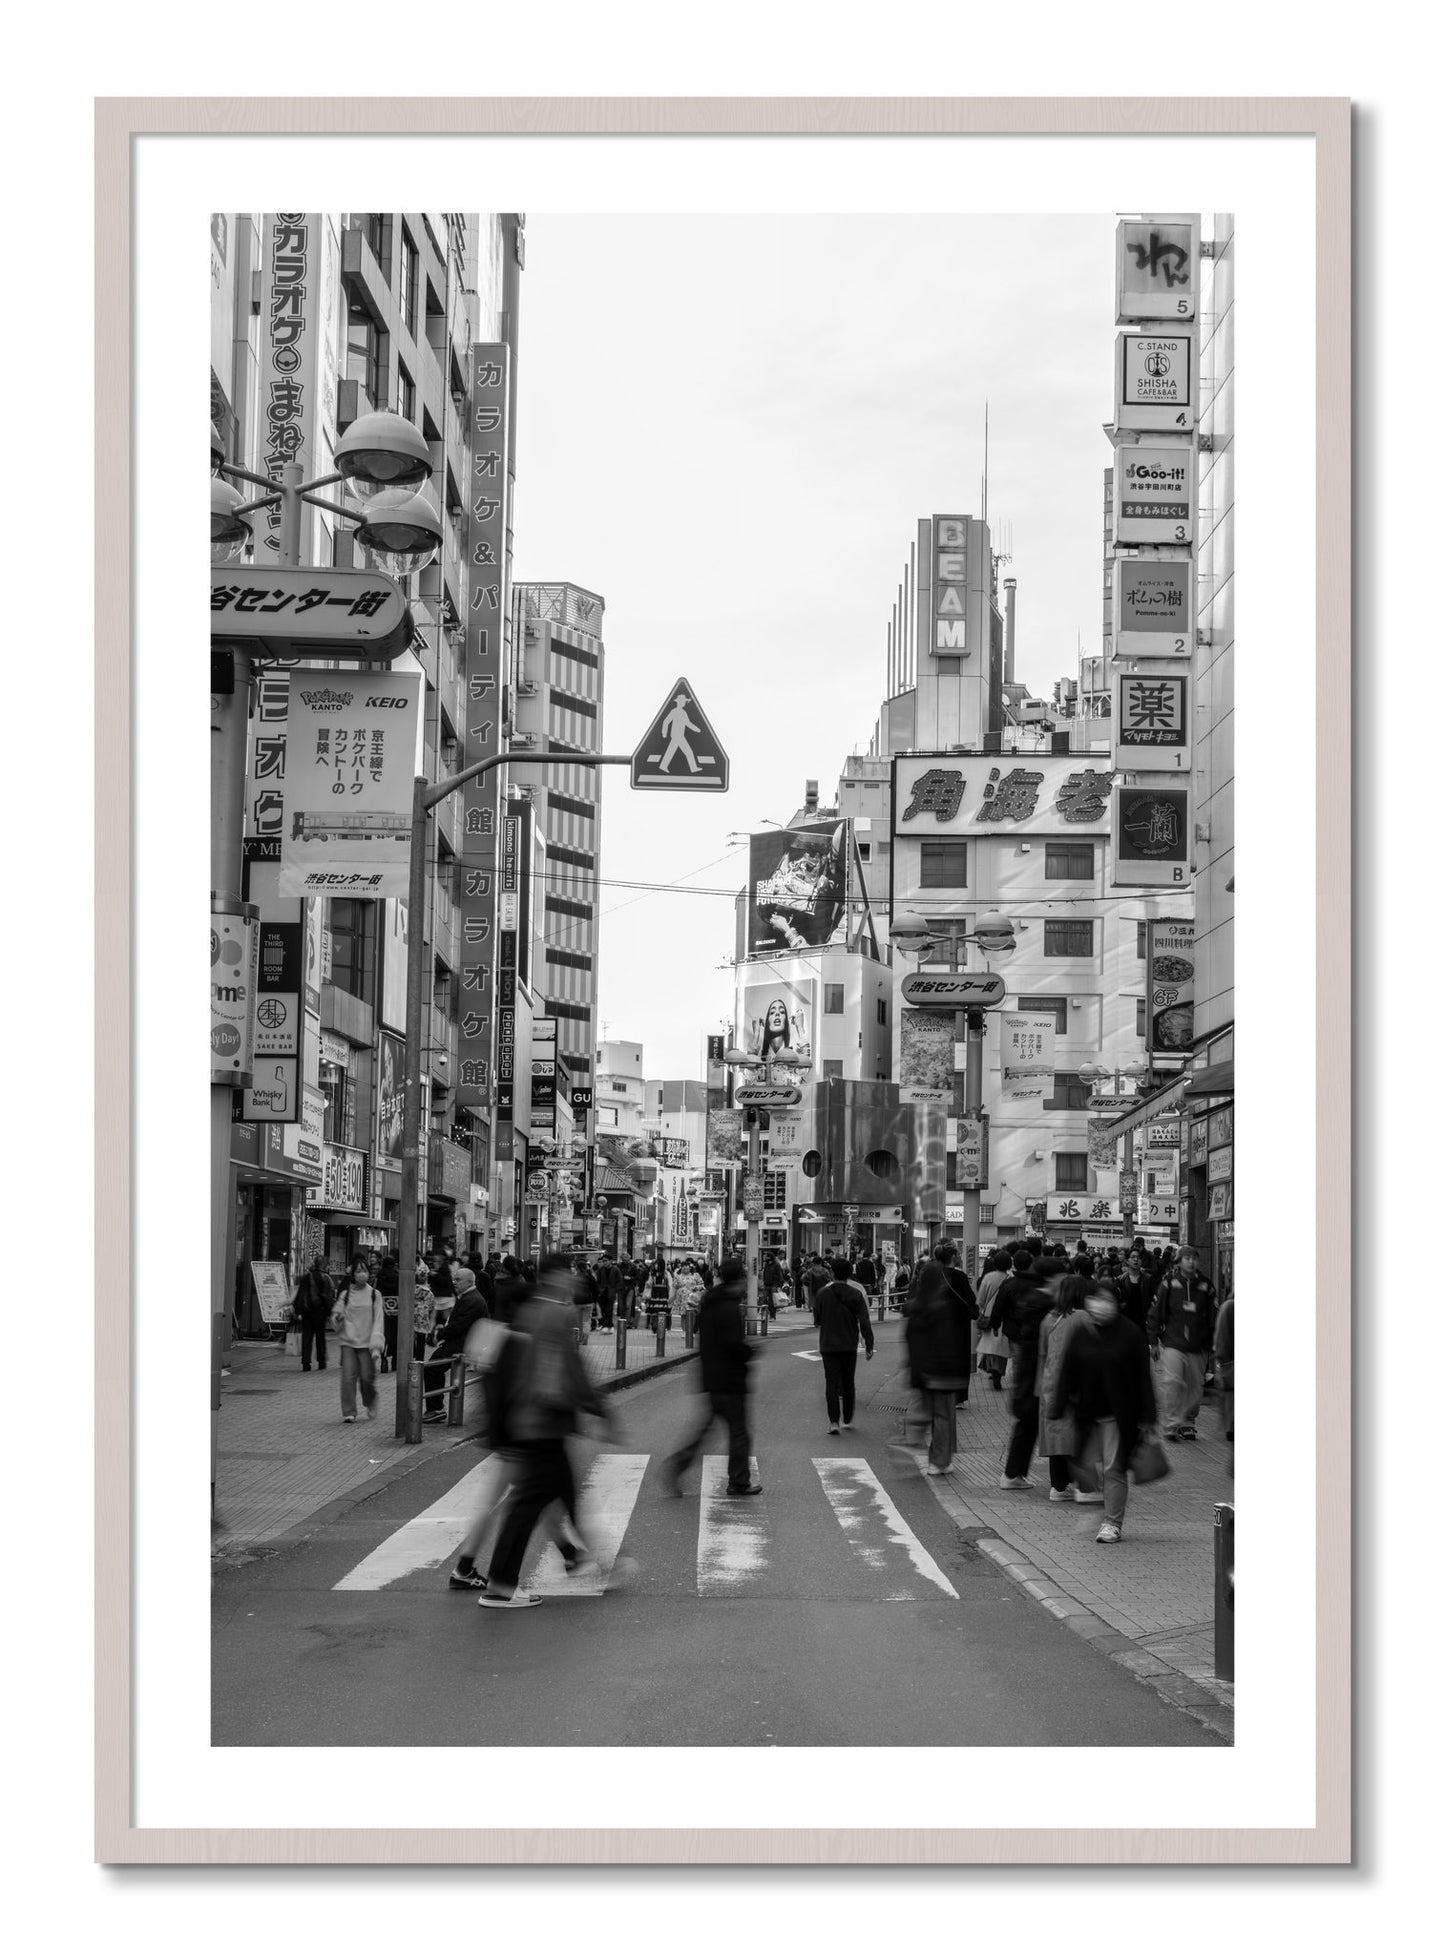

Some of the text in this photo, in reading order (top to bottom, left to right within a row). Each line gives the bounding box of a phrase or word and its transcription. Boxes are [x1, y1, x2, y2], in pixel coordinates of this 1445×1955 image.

[271, 223, 307, 347] カラオケ
[1176, 300, 1188, 314] 5
[1137, 342, 1178, 351] C.STAND
[1137, 379, 1178, 388] SHISHA
[1137, 388, 1178, 396] CAFE&BAR
[1136, 466, 1185, 480] Goo-it!
[1125, 506, 1186, 516] 全身もみほぐし
[1175, 526, 1186, 540] 3
[936, 519, 966, 648] BEAM
[1174, 639, 1185, 652] 2
[365, 696, 408, 709] KEIO
[1129, 682, 1175, 728] 薬
[1123, 730, 1180, 743] マツモトキヨシ
[316, 728, 330, 767] 冒険へ
[332, 729, 348, 794] カントーの
[369, 730, 384, 783] 京王線で
[1173, 753, 1182, 767] 1
[902, 767, 1113, 822] 角海老
[1124, 803, 1178, 845] 一蘭
[506, 821, 515, 853] kimono
[304, 873, 384, 885] 渋谷センター街
[1172, 867, 1184, 882] B
[907, 980, 1000, 993] 渋谷センター街
[1152, 989, 1179, 1007] 6F
[253, 1090, 283, 1100] Whisky
[573, 1093, 591, 1103] GU
[738, 1090, 794, 1099] 渋谷センター街
